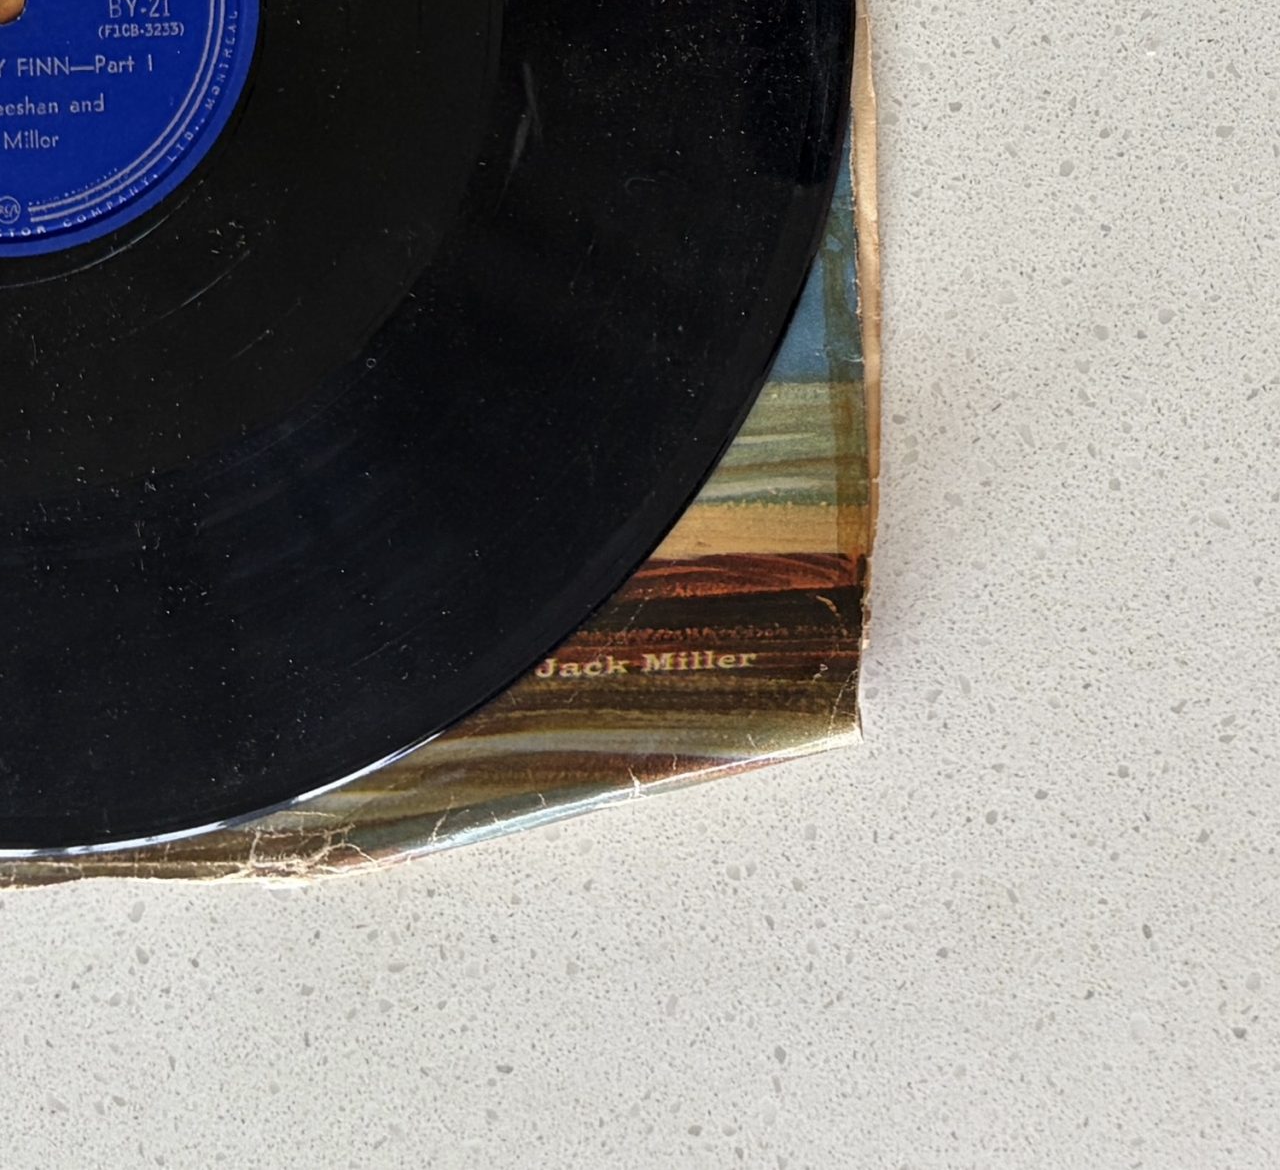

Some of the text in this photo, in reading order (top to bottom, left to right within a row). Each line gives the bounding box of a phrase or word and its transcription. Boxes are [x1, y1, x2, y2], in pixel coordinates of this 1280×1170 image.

[205, 10, 239, 111] MONTREAL
[69, 92, 105, 114] and
[534, 650, 758, 679] Jack Miller
